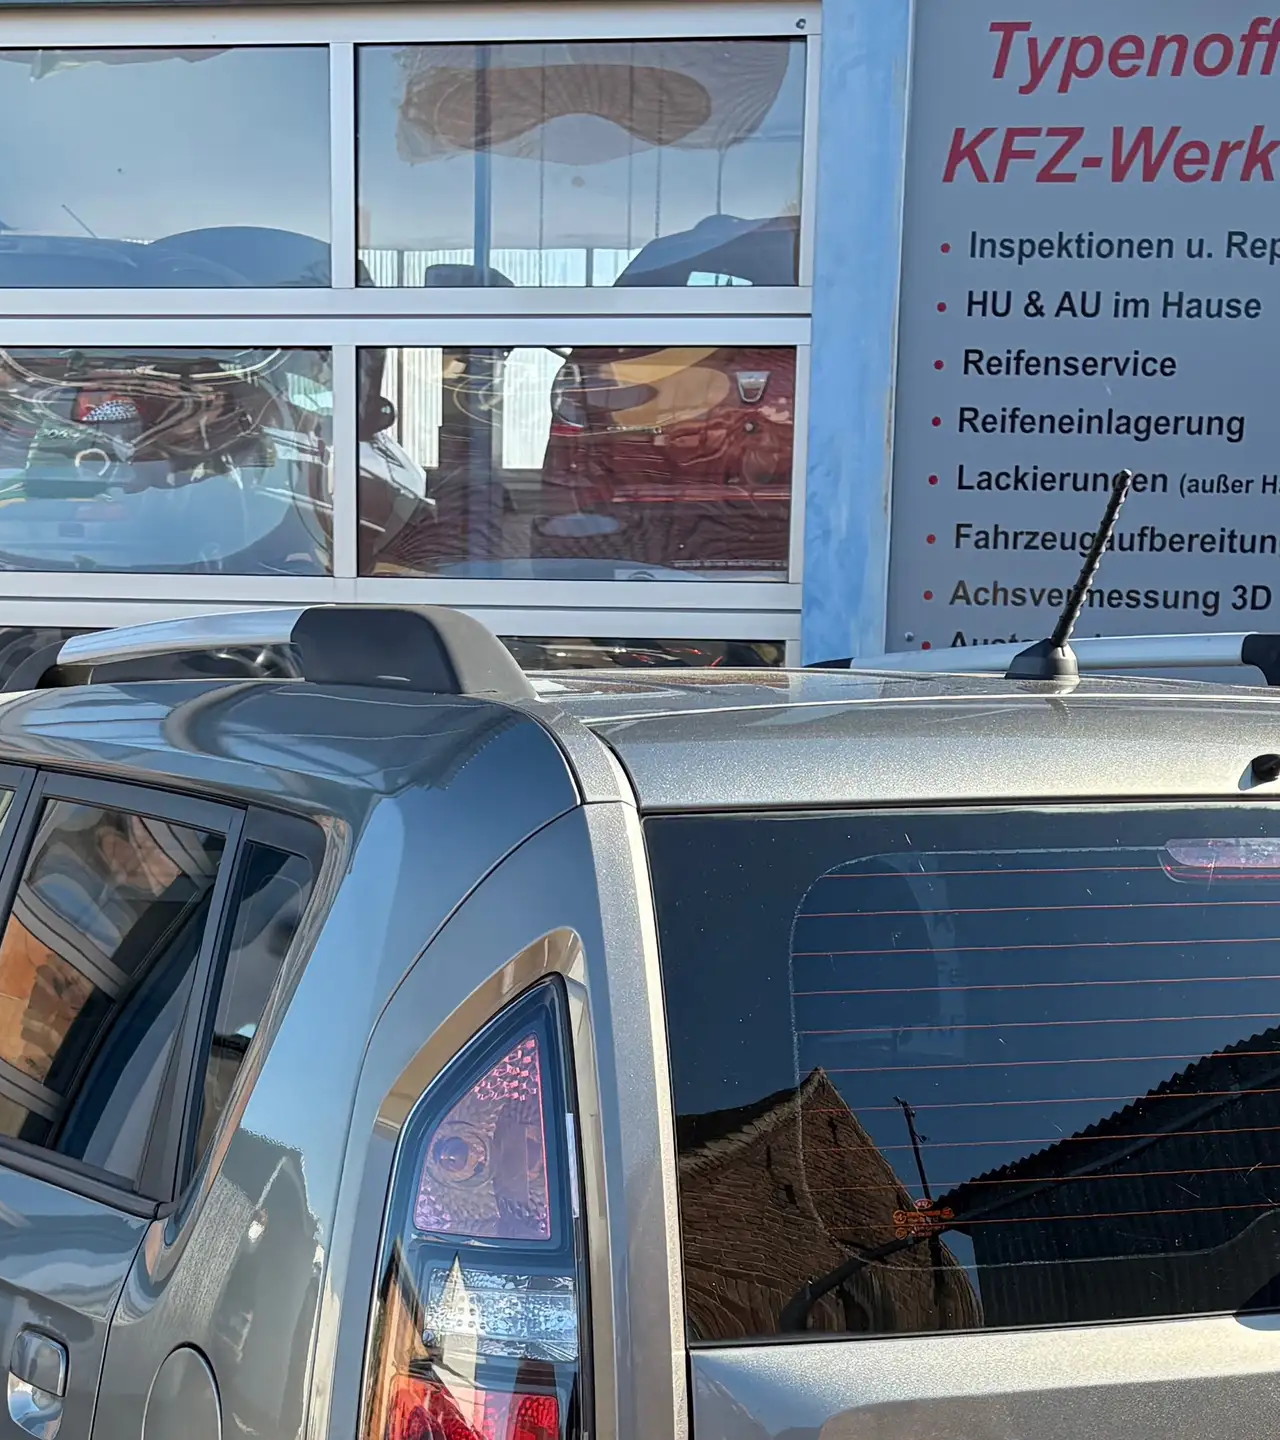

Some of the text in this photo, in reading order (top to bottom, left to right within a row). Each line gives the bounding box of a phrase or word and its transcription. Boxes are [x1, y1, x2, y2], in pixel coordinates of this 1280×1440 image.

[969, 230, 1174, 267] Inspektionen
[1186, 238, 1213, 259] u.
[966, 289, 1262, 319] HU & AU im Hause
[963, 348, 1177, 377] Reifenservice
[958, 406, 1245, 444] Reifeneinlagerung
[1179, 473, 1255, 499] (außer
[1231, 584, 1272, 612] 3D
